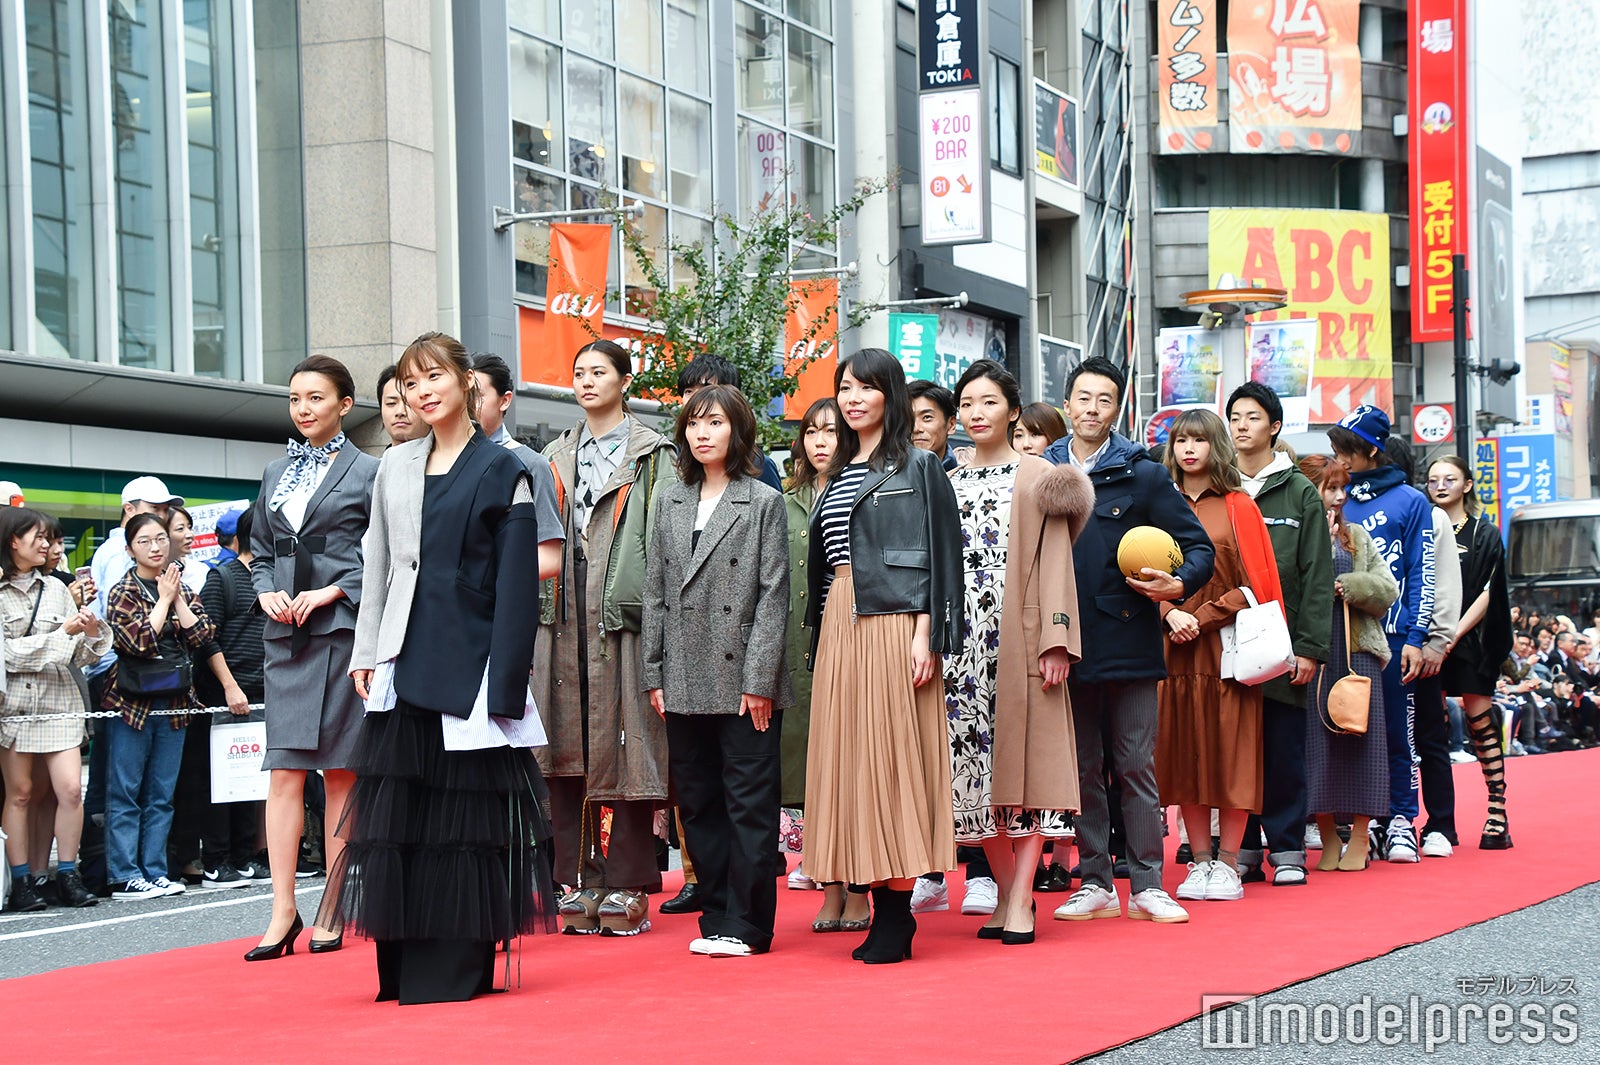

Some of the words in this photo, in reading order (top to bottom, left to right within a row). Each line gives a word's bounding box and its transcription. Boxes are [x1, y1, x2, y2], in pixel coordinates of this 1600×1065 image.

[1421, 18, 1454, 53] 場
[927, 68, 973, 85] TOKIA
[931, 115, 971, 135] ¥200
[935, 138, 967, 160] BAR
[933, 179, 947, 194] B1
[1240, 227, 1374, 305] ABC
[550, 292, 601, 317] au
[230, 743, 260, 754] neo
